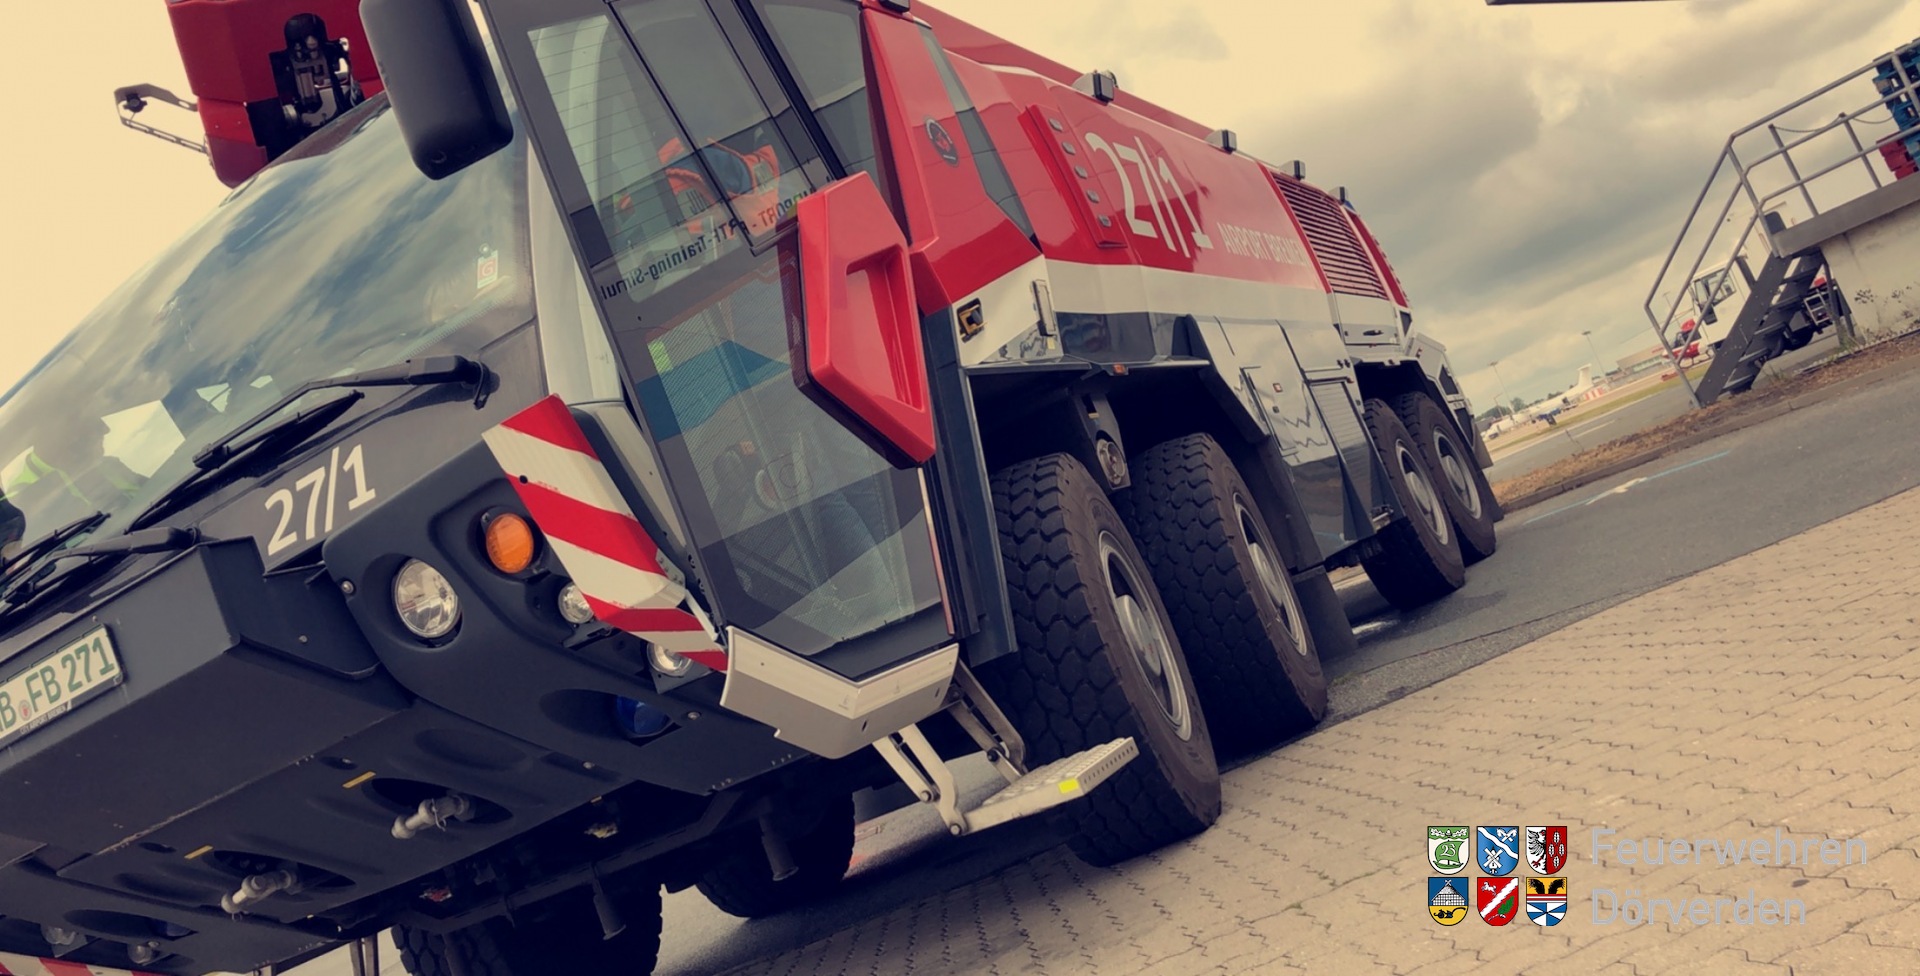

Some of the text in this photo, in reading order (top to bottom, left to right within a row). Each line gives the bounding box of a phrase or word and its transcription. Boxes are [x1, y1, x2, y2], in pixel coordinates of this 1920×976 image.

[1084, 131, 1214, 259] 27/1
[1216, 221, 1272, 261] AIRPORT
[264, 443, 377, 557] 27/1
[0, 636, 115, 731] B FB 271
